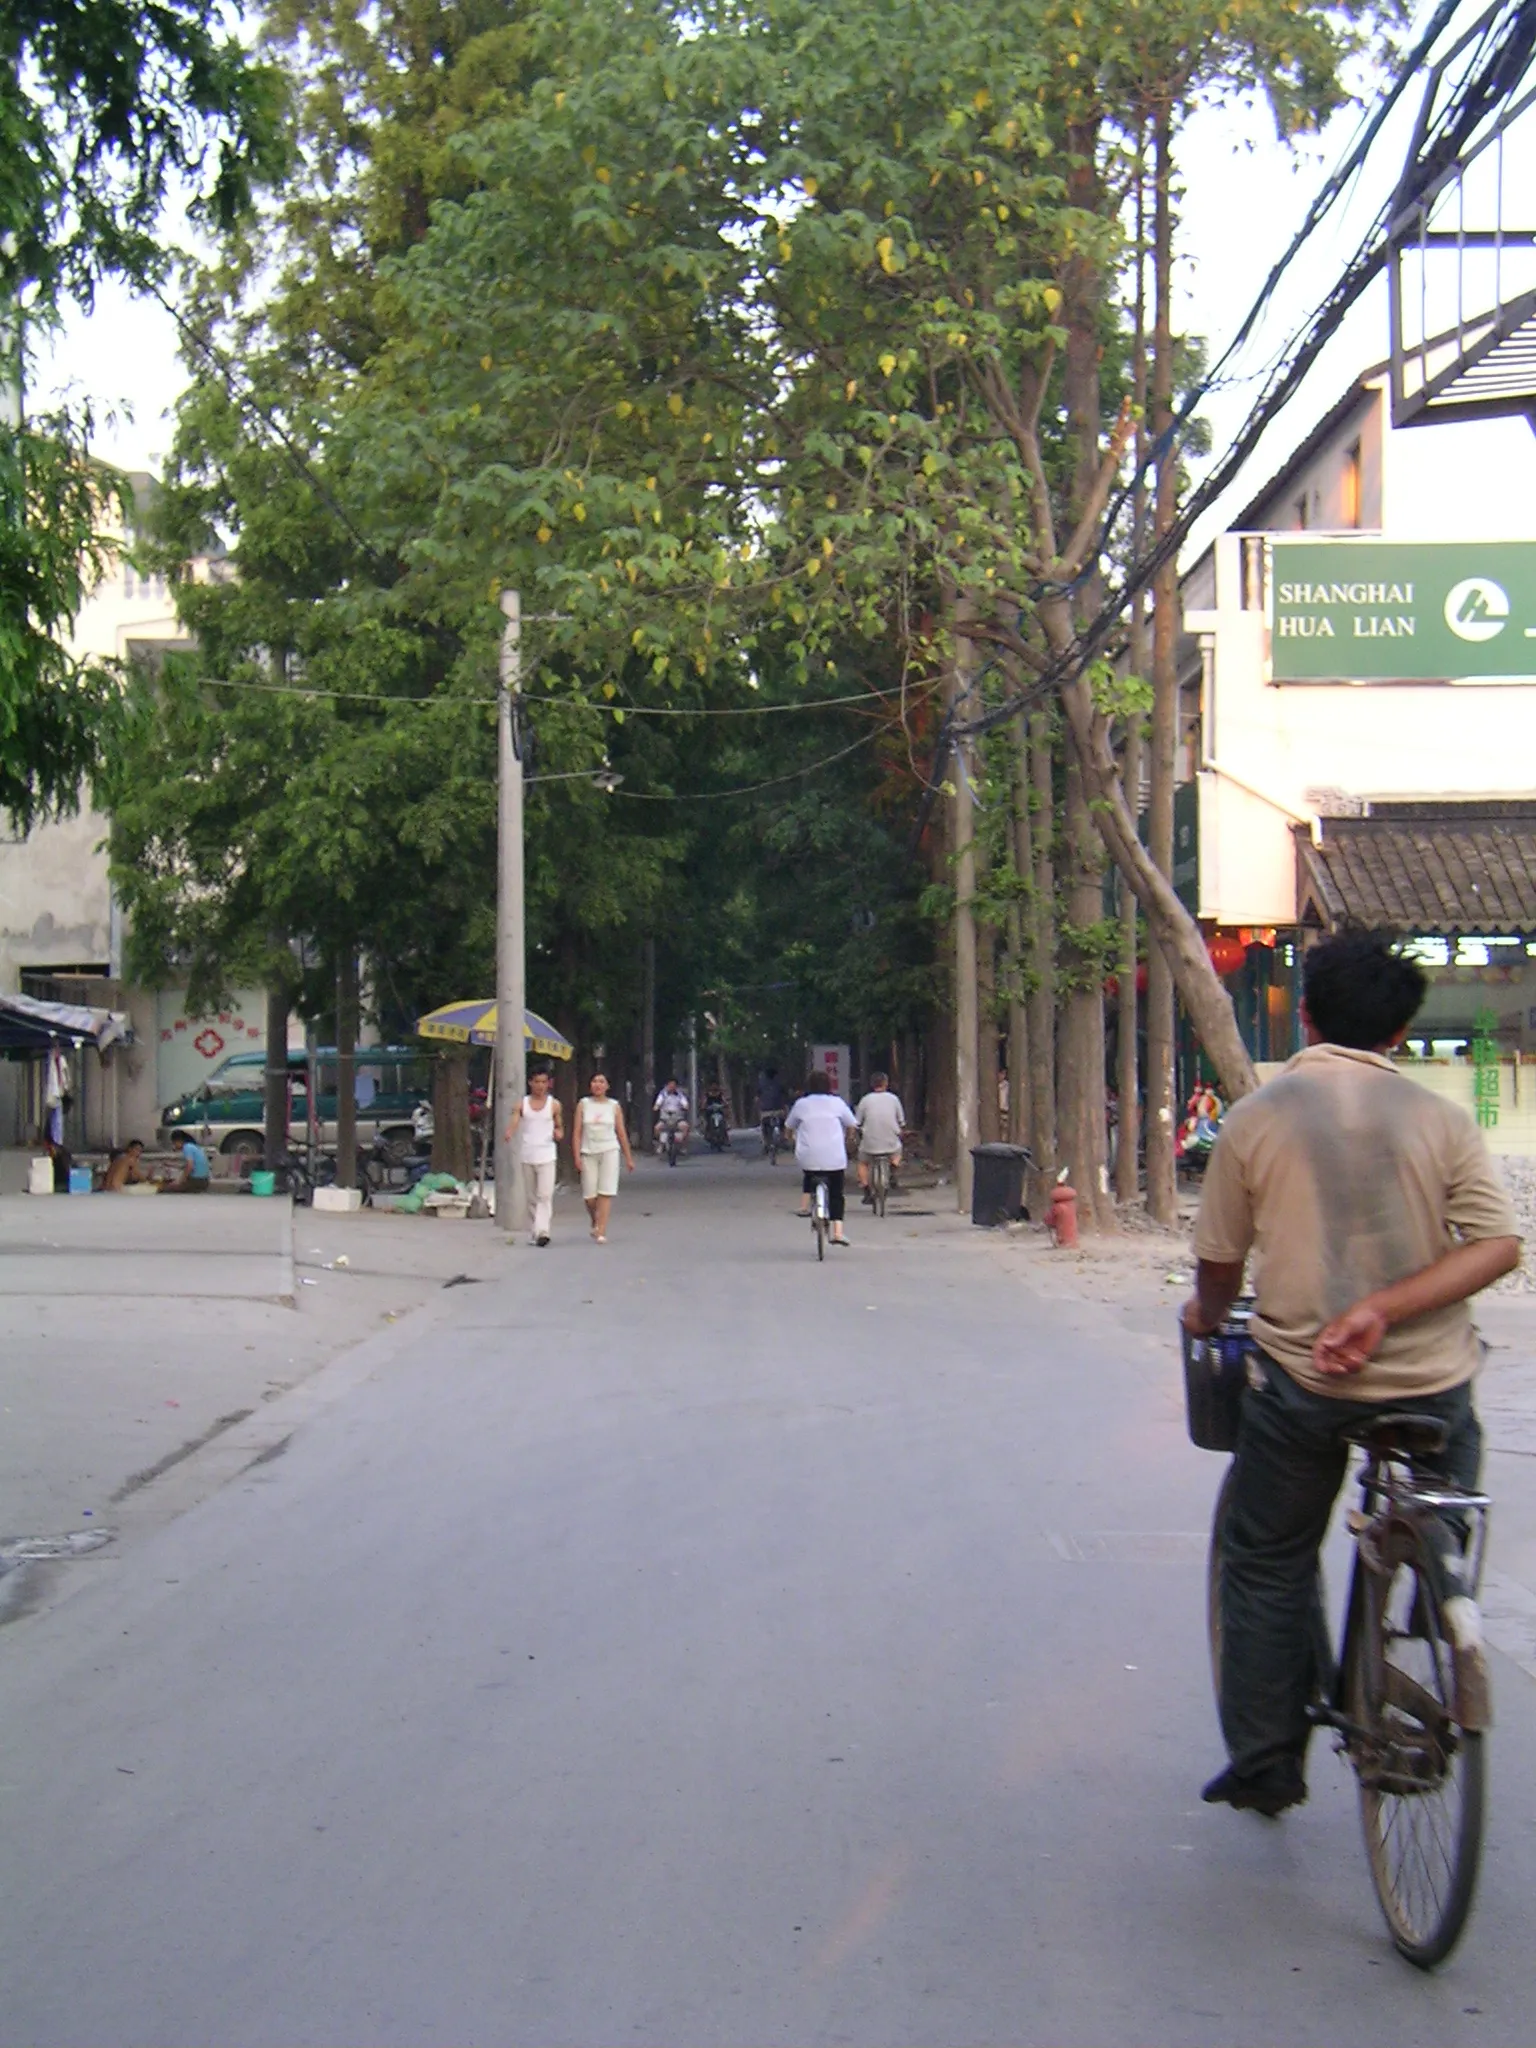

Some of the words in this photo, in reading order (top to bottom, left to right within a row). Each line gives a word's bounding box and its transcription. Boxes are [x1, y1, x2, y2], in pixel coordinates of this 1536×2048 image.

[1278, 582, 1415, 604] SHANGHAI
[1278, 615, 1336, 637] HUA
[1353, 615, 1416, 637] LIAN
